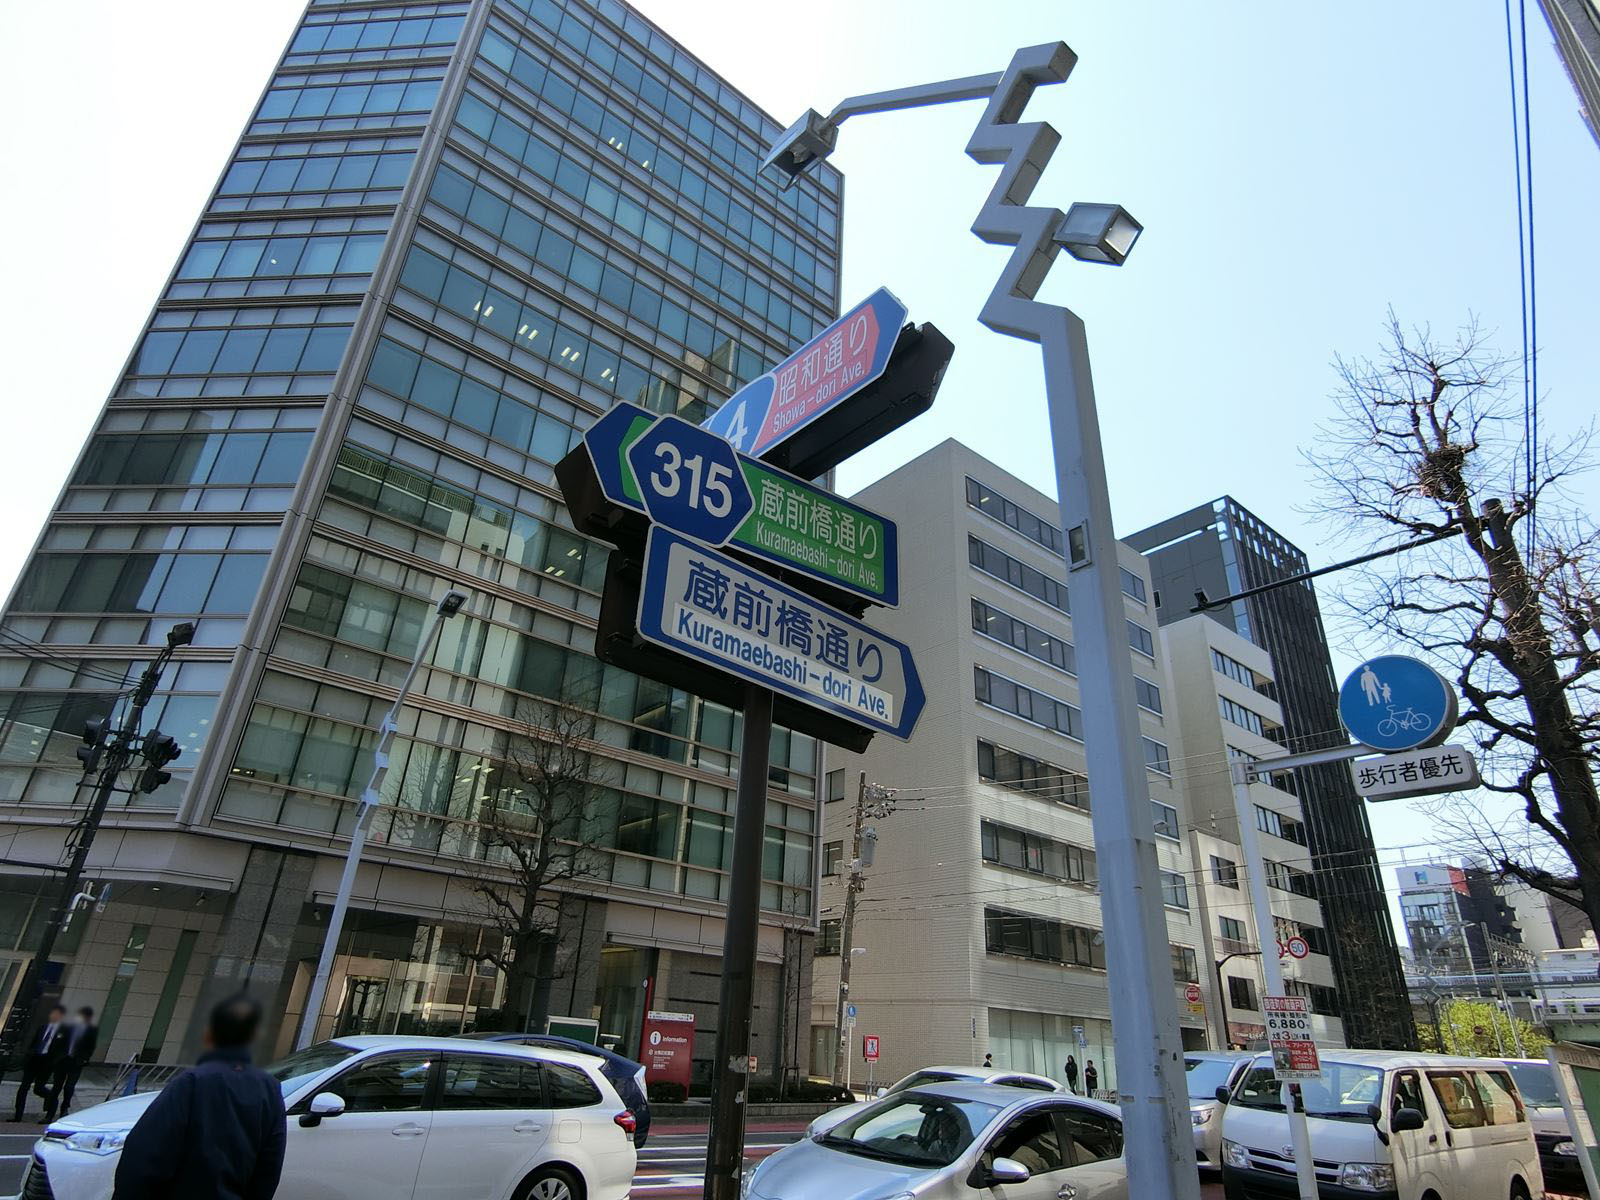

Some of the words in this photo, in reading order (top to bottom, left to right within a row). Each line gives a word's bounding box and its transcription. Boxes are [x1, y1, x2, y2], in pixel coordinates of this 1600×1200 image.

[778, 315, 867, 407] 昭和通り
[724, 400, 748, 449] 4
[773, 374, 836, 433] Showa-dori
[841, 363, 865, 386] Ave.
[651, 442, 733, 518] 315
[758, 478, 877, 559] 蔵前橋通り
[756, 521, 855, 579] Kuramaebashi-dori
[858, 566, 879, 590] Ave.
[684, 560, 883, 683] 蔵前橋通り
[678, 608, 852, 704] Kuramaebashi-dori
[857, 692, 889, 719] Ave.
[1358, 754, 1463, 788] 歩行者優先
[1291, 942, 1304, 953] 50
[662, 1035, 688, 1043] Information
